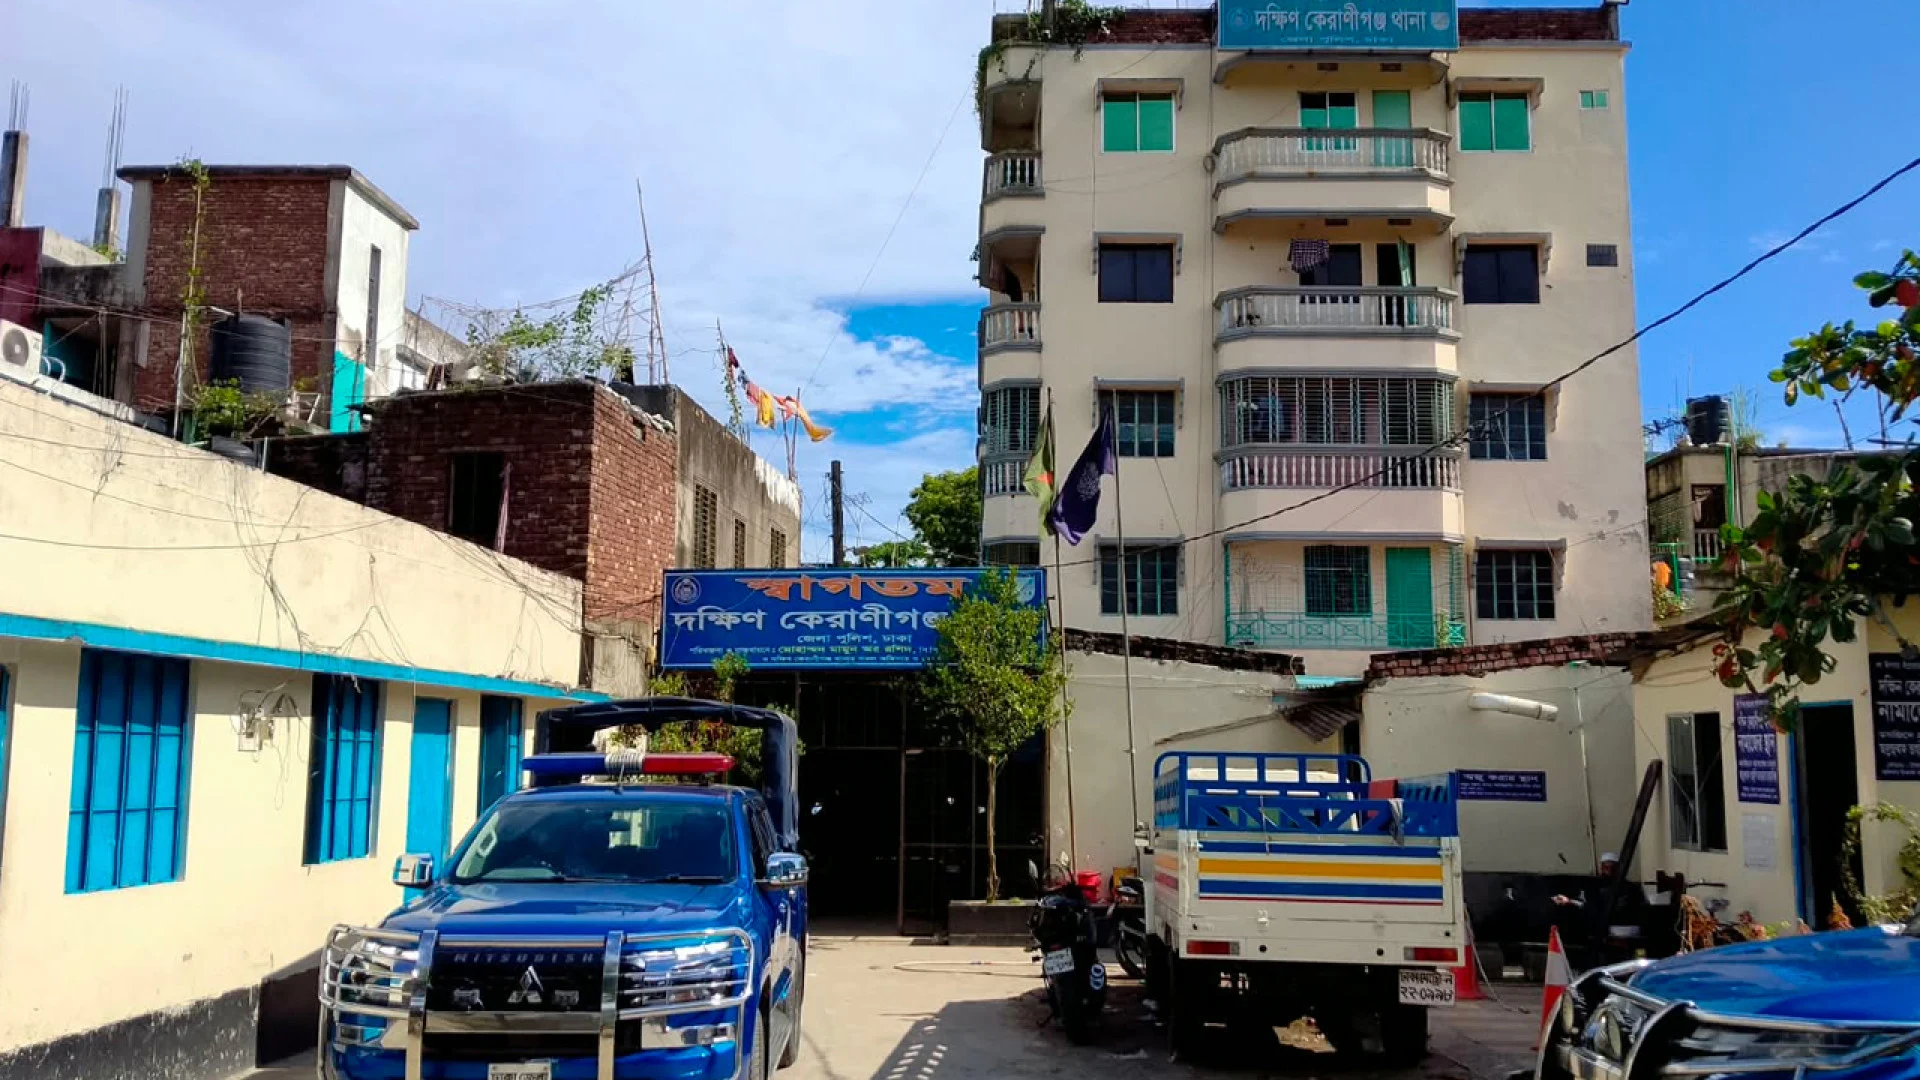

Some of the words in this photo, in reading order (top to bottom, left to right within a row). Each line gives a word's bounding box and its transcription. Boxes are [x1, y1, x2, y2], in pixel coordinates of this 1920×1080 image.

[1254, 2, 1300, 32] দক্ষিণ
[1391, 8, 1427, 32] থানা
[735, 573, 973, 601] স্বাগতম
[669, 605, 768, 631] দক্ষিণ
[797, 634, 831, 644] জেলা
[882, 634, 912, 644] ঢাকা
[454, 953, 605, 963] MITSUBISH
